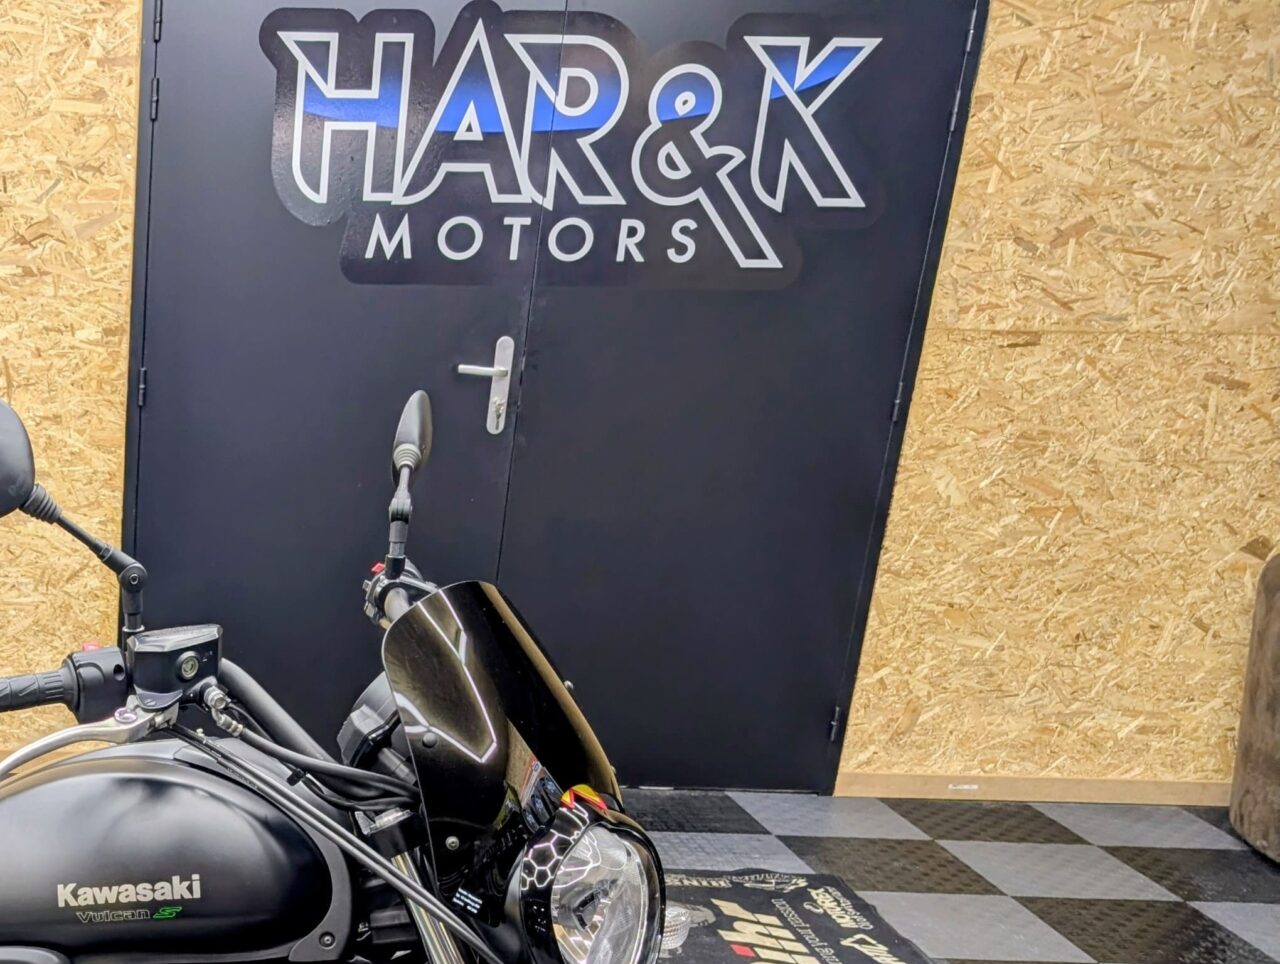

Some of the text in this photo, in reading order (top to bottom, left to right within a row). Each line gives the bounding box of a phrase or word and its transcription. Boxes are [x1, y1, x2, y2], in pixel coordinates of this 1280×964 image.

[365, 213, 697, 263] MOTORS
[57, 874, 201, 907] Kawasaki
[76, 907, 183, 923] Vulcan S
